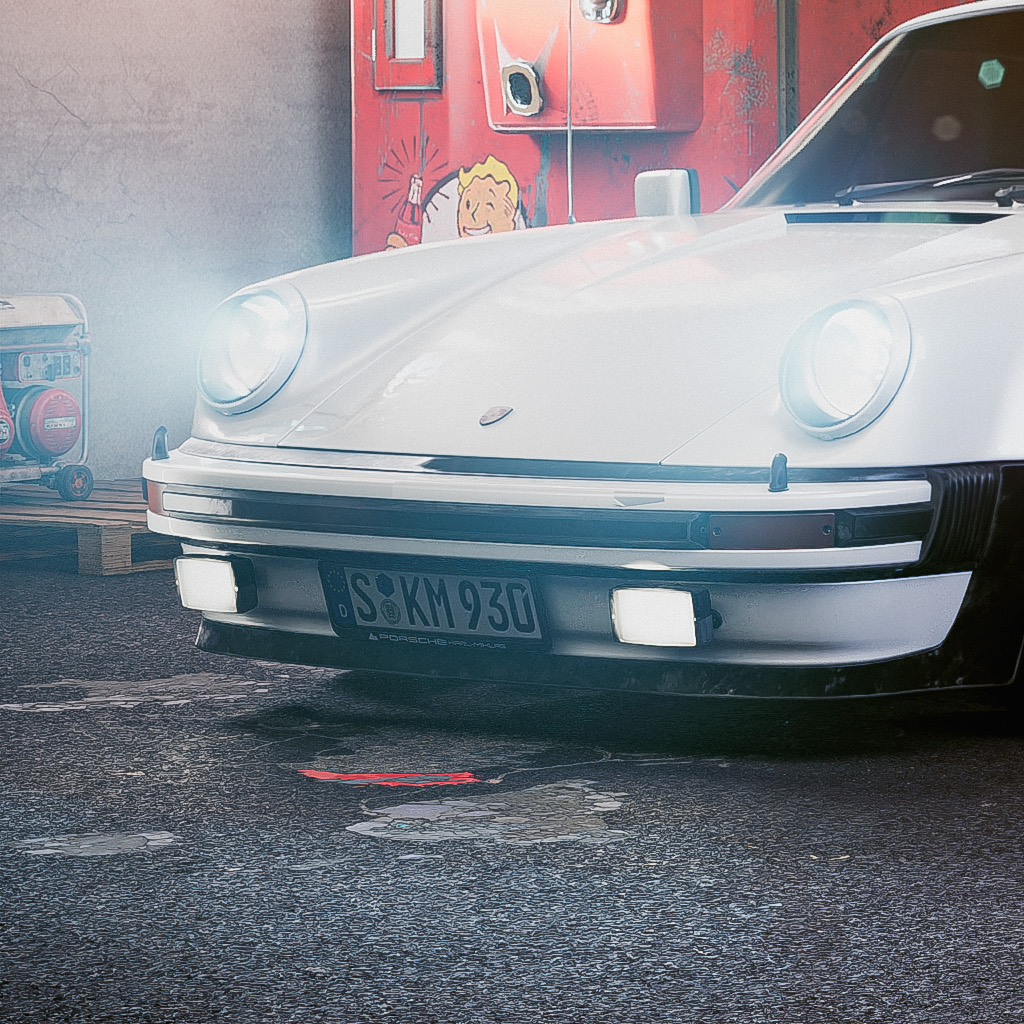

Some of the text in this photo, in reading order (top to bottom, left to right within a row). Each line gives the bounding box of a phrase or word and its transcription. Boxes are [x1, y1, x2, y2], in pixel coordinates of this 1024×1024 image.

[338, 604, 348, 619] D
[398, 575, 455, 629] KM
[458, 578, 537, 634] 930
[378, 633, 448, 646] PORSCHE
